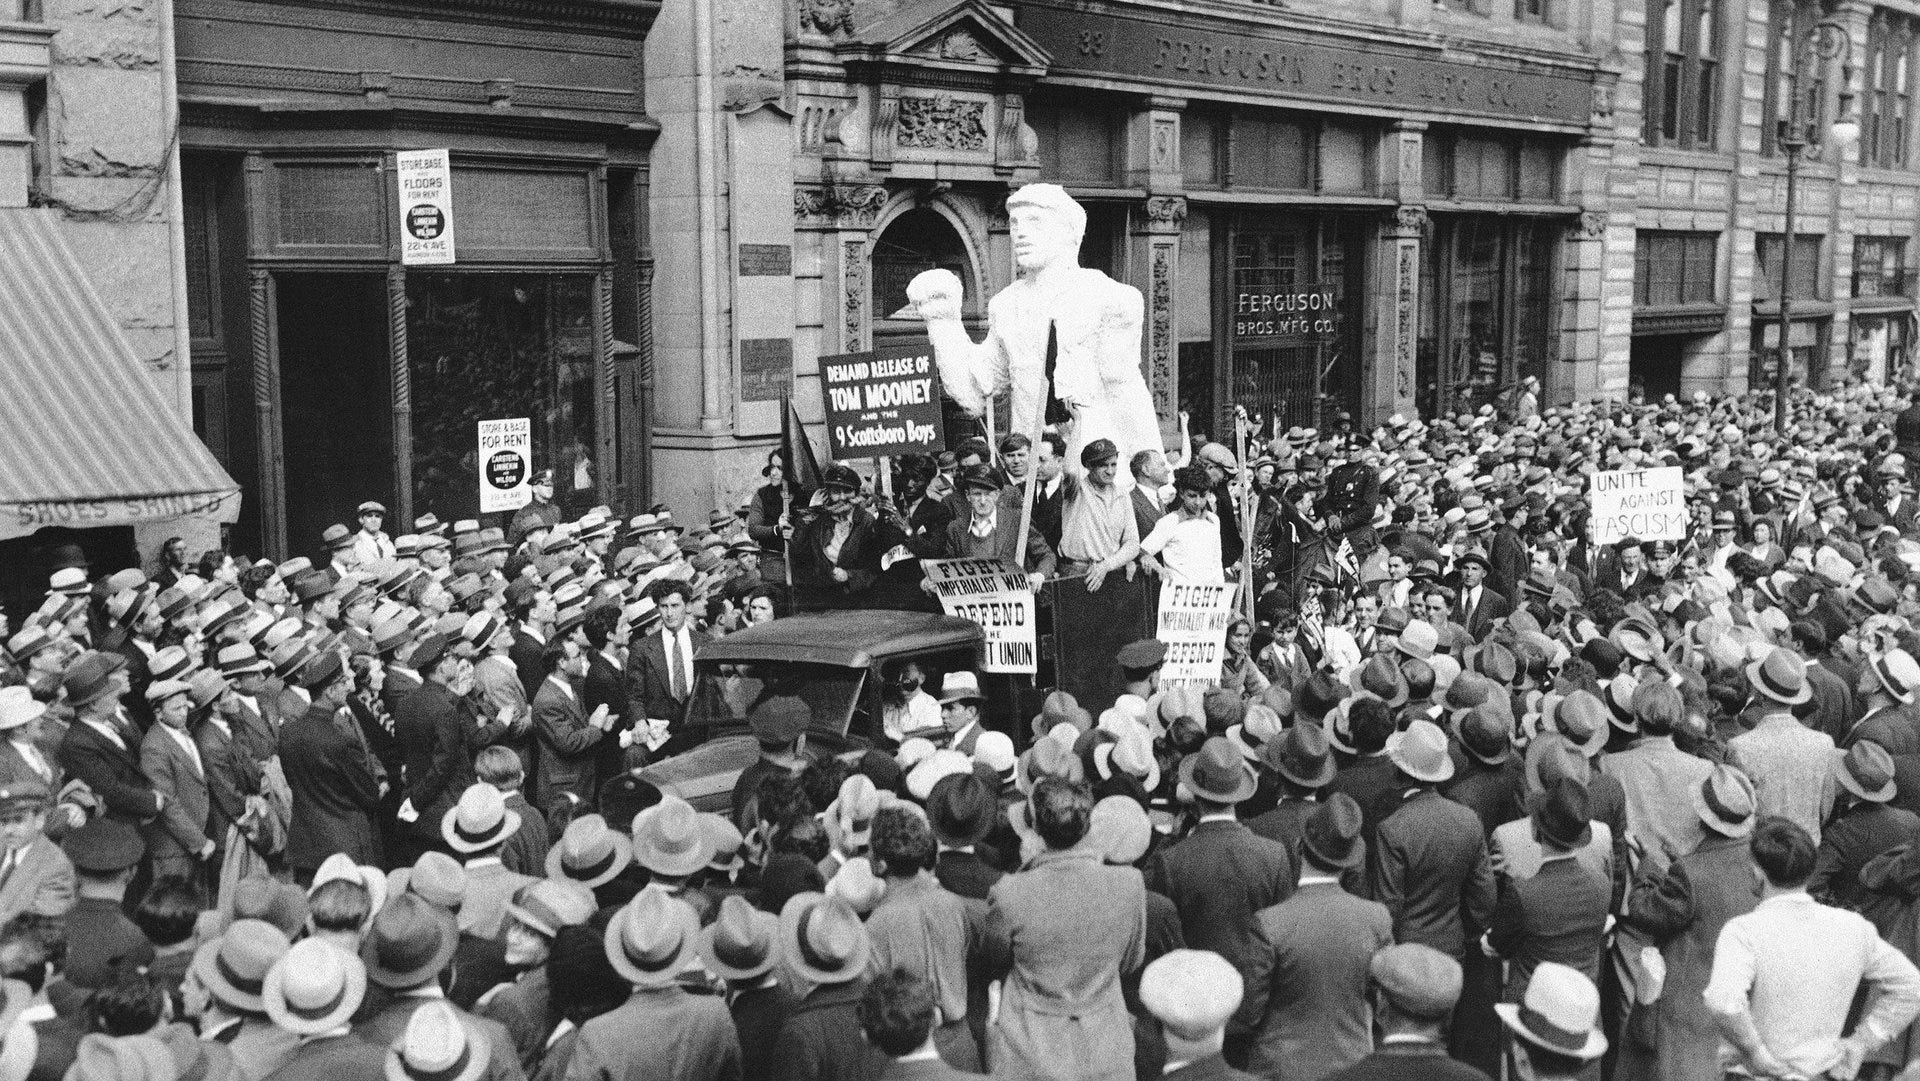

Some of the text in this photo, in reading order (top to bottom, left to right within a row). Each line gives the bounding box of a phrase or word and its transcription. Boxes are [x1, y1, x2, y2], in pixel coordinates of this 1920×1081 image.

[1153, 37, 1303, 83] FERGUSON
[404, 177, 443, 189] FLOORS
[408, 190, 439, 199] FOR RENT
[1239, 293, 1333, 312] FERGUSON
[826, 355, 930, 382] DEMAND RELEASE OF
[829, 378, 932, 412] TOM MOONEY
[860, 412, 879, 421] AND
[482, 433, 527, 449] FOR RENT
[835, 419, 936, 448] 9 Scottsboro Boys
[1597, 471, 1648, 491] UNITE
[1619, 490, 1674, 510] AGAINST
[18, 503, 108, 526] SHOES
[1595, 513, 1684, 537] FASCISM
[936, 560, 1005, 578] FIGHT
[936, 573, 1029, 597] IMPERIALIST WAR
[1171, 585, 1224, 608] FIGHT
[1160, 611, 1226, 631] IMPERIALIST WAR
[999, 641, 1033, 666] UNION
